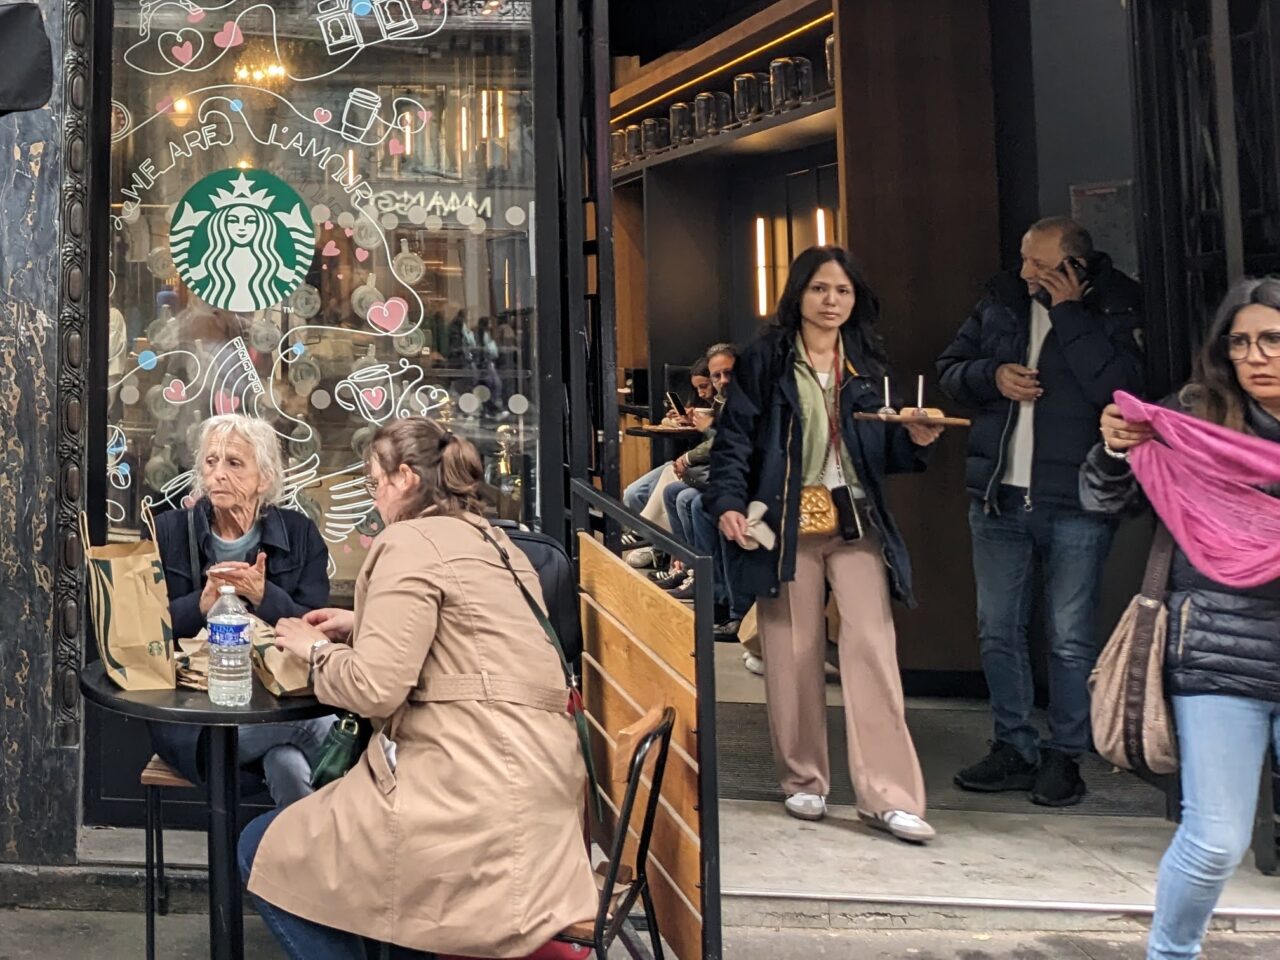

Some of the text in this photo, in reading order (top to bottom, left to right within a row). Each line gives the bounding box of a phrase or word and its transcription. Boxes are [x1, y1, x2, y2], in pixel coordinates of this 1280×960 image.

[121, 158, 155, 205] WE
[169, 123, 221, 162] ARE
[283, 306, 295, 314] TM
